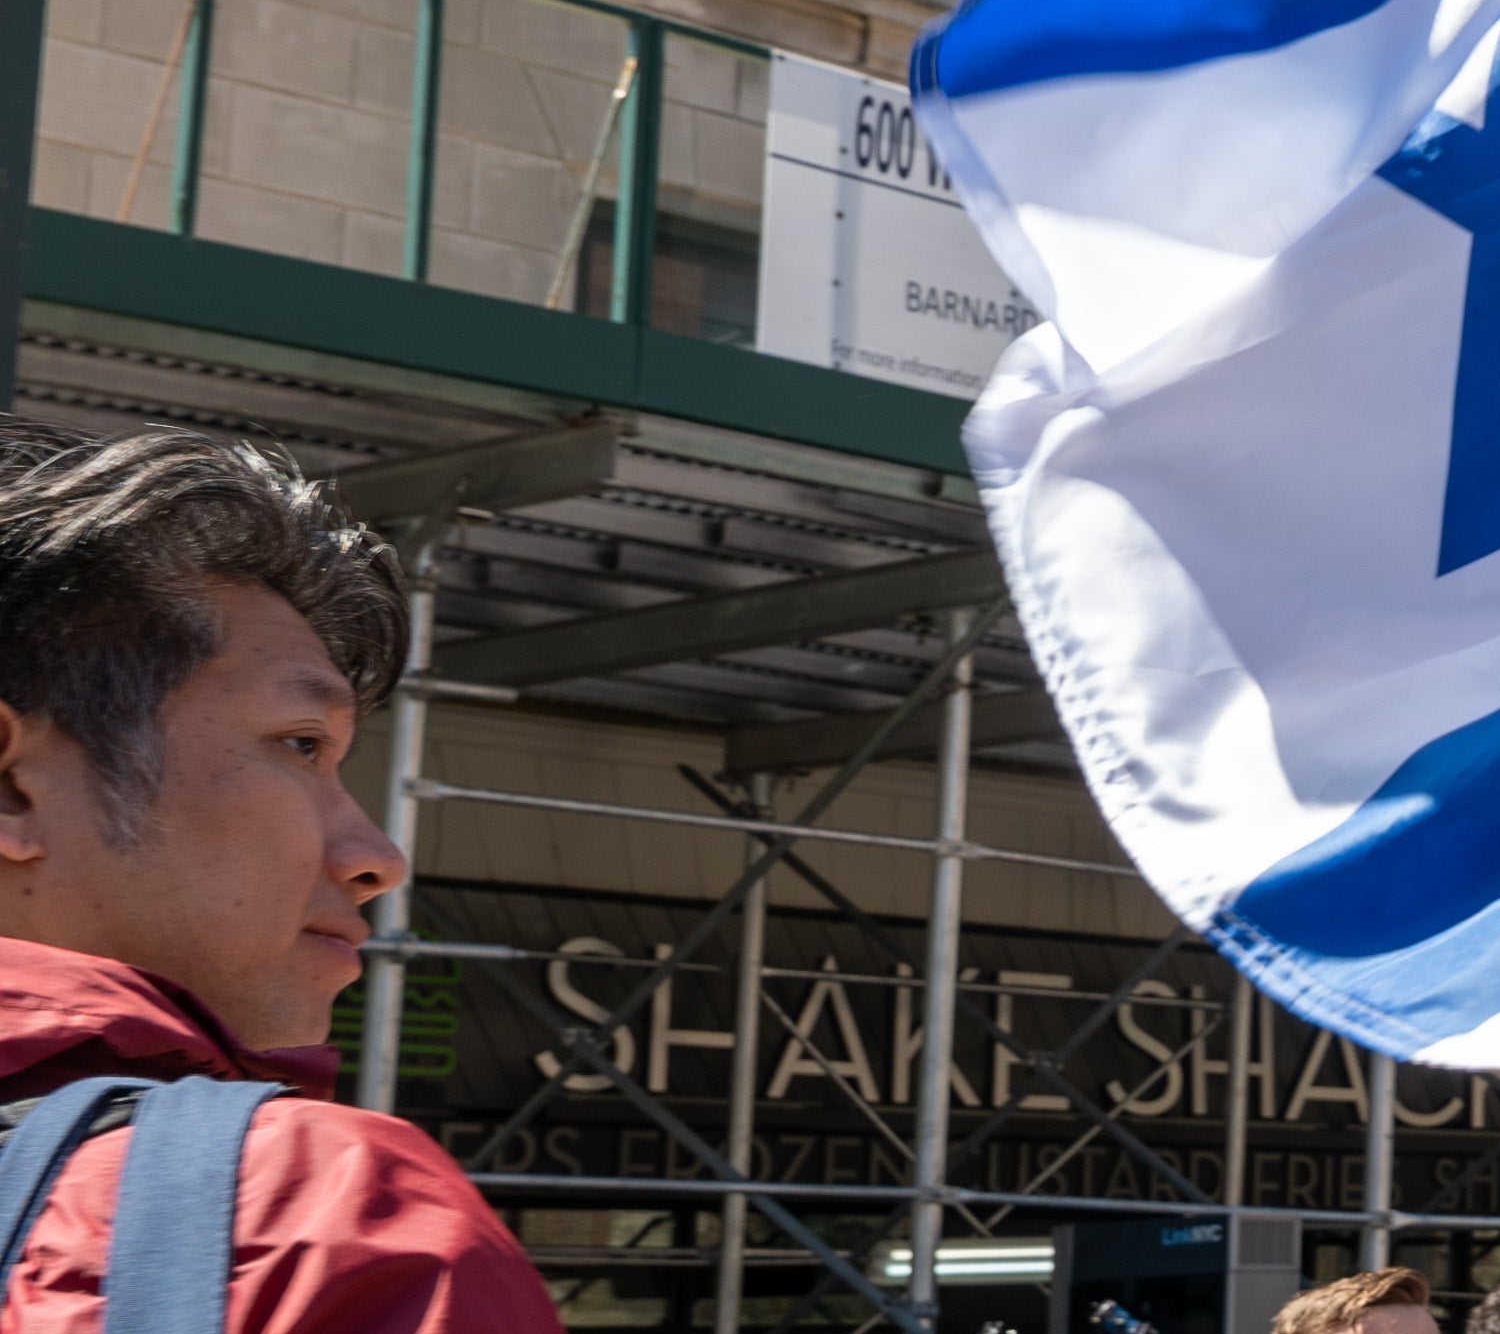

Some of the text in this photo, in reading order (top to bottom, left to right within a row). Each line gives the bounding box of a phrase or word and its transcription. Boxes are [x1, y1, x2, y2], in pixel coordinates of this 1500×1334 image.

[855, 95, 915, 180] 600
[905, 280, 1036, 336] BARNARD
[533, 936, 1074, 1110] SHAKE
[952, 1139, 1225, 1204] USTARD
[1252, 1151, 1398, 1208] FRIE
